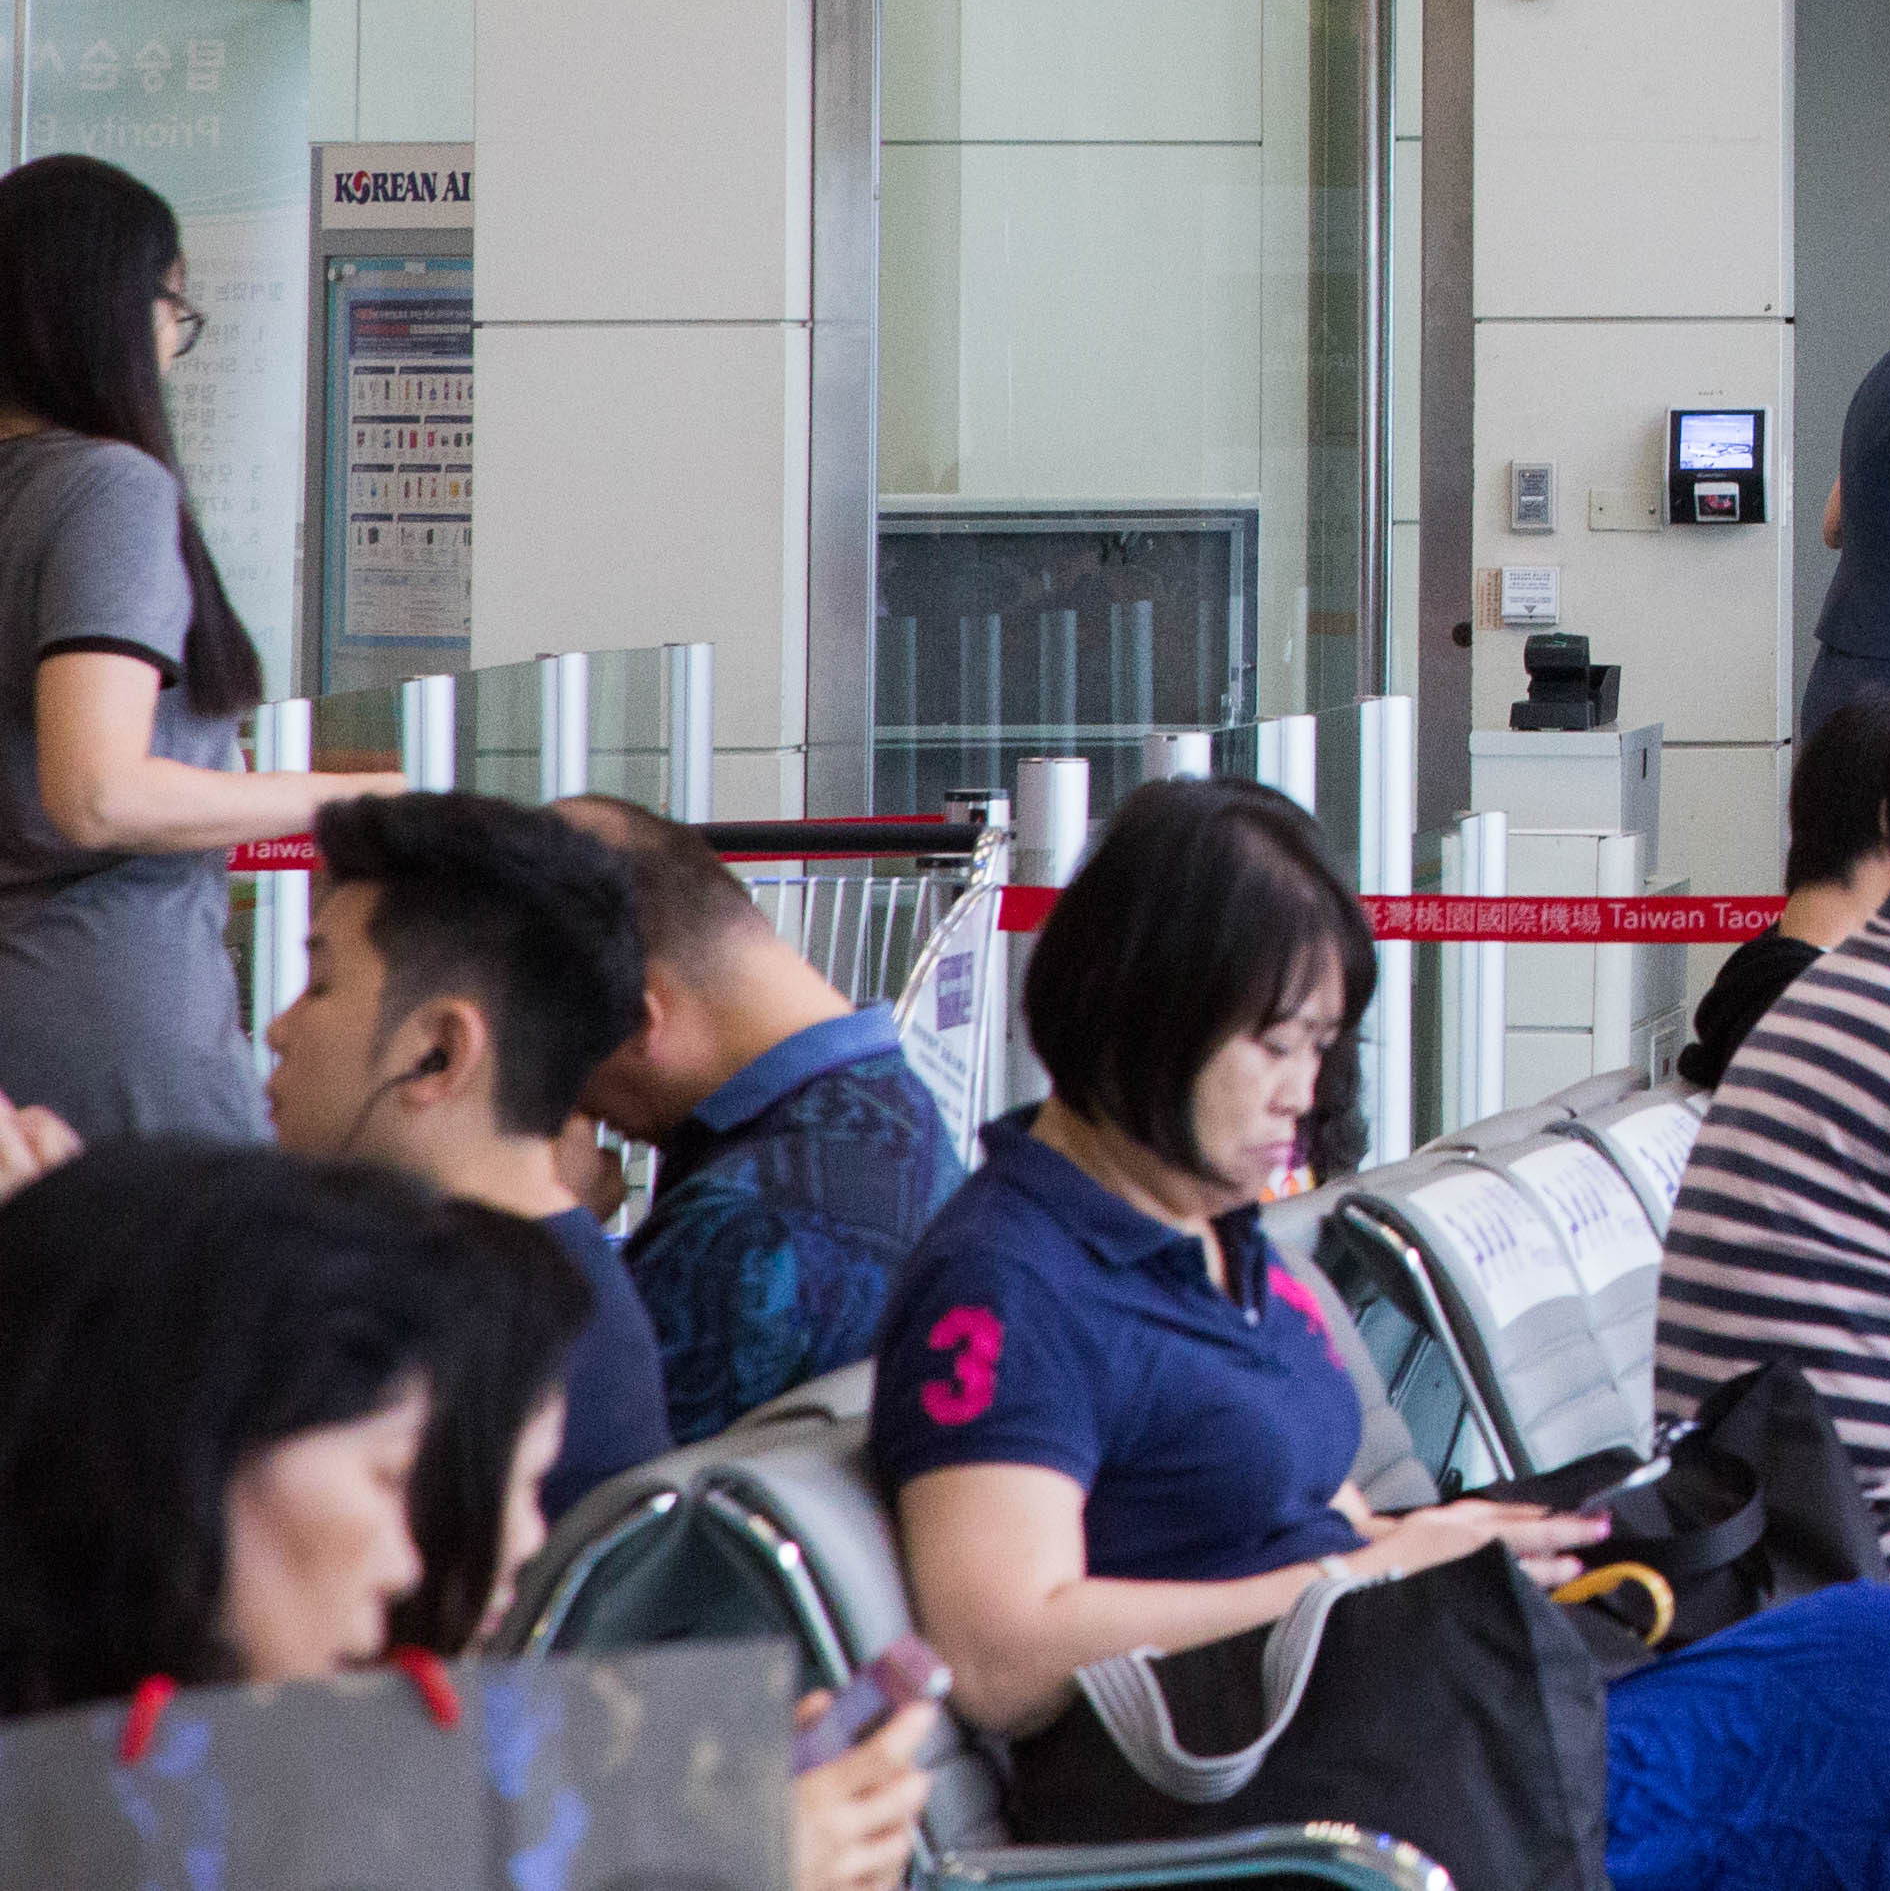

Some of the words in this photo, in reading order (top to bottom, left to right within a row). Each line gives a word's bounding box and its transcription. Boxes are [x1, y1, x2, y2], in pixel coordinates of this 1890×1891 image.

[335, 170, 437, 204] KOREAN
[441, 171, 471, 202] AI
[247, 841, 315, 859] aiwa
[1608, 902, 1705, 930] Taiwan
[921, 1305, 1005, 1426] 3
